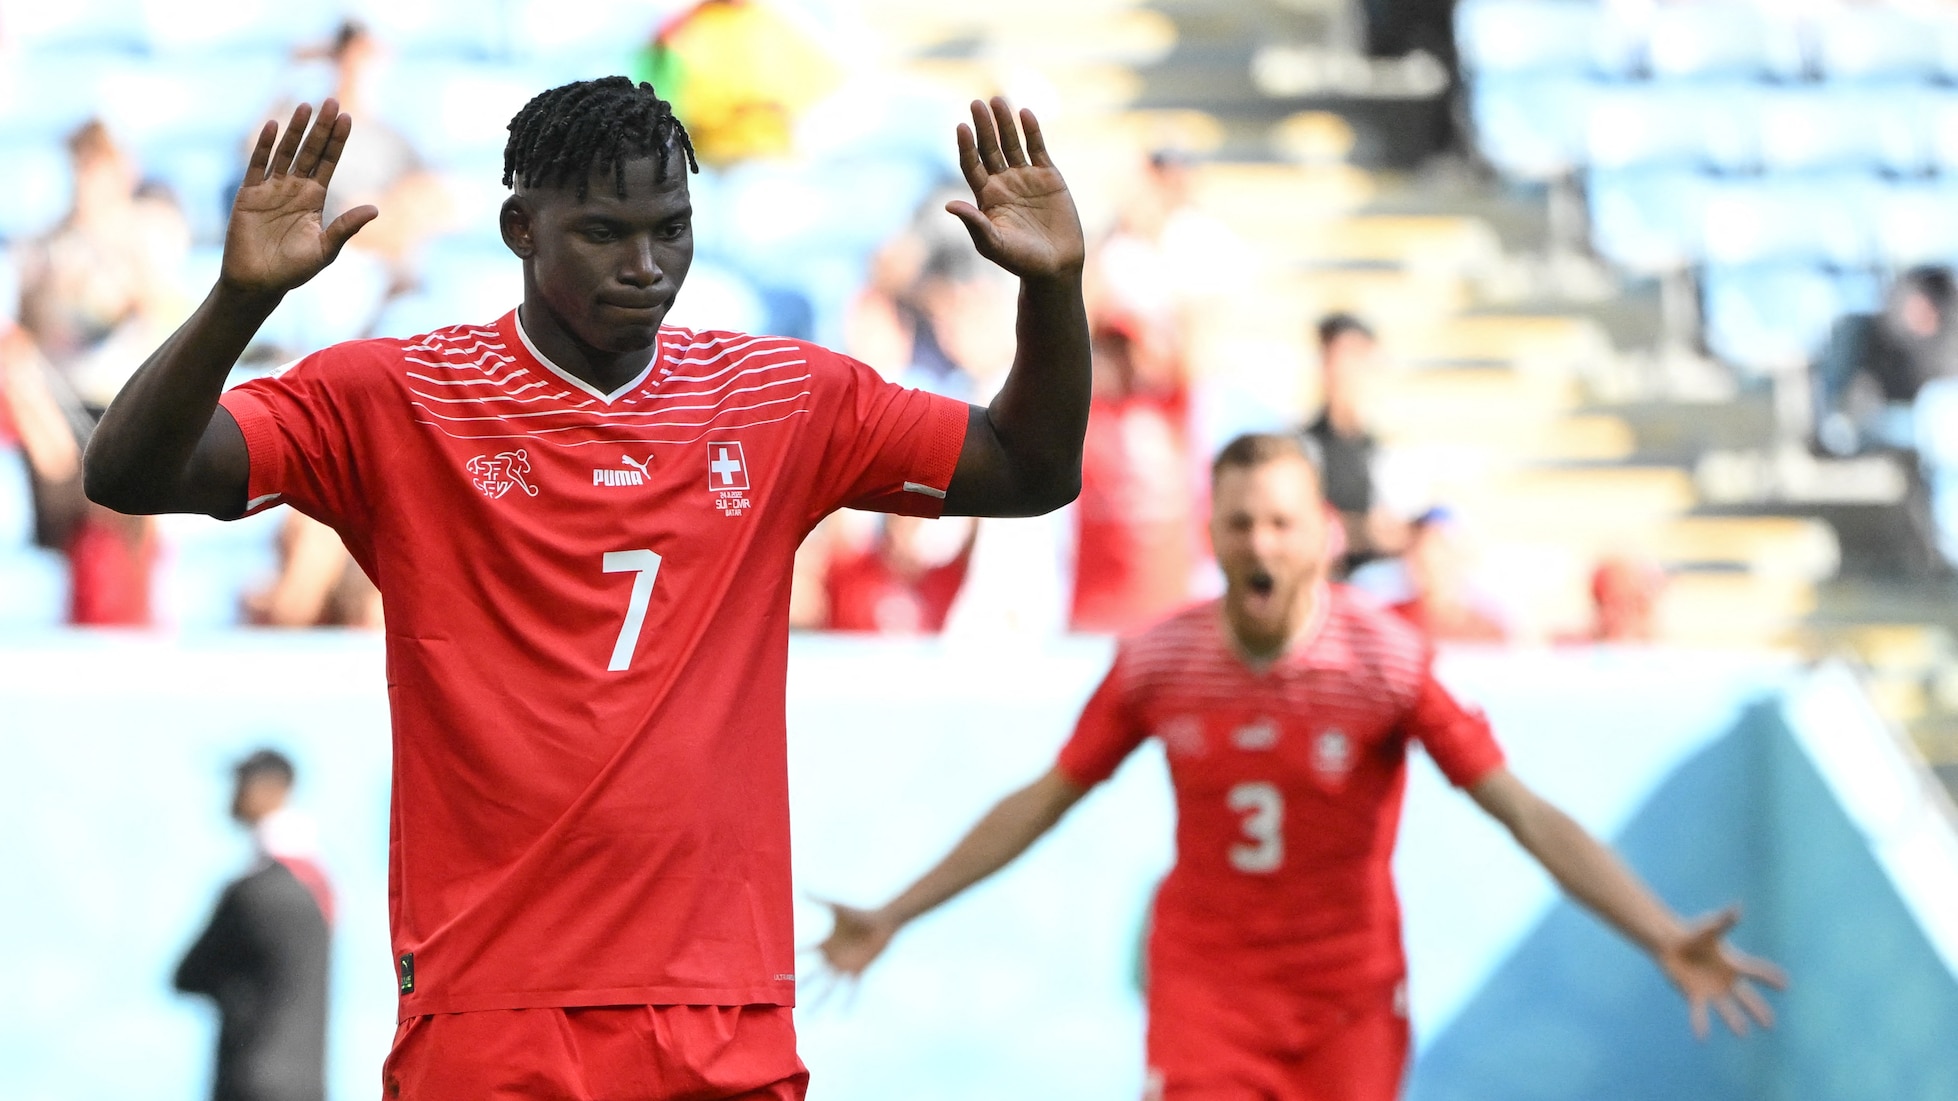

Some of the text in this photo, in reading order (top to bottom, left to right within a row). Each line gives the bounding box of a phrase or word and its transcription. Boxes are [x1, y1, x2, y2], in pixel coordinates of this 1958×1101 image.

[593, 469, 643, 486] PUMA
[603, 549, 662, 671] 7
[1227, 781, 1285, 874] 3
